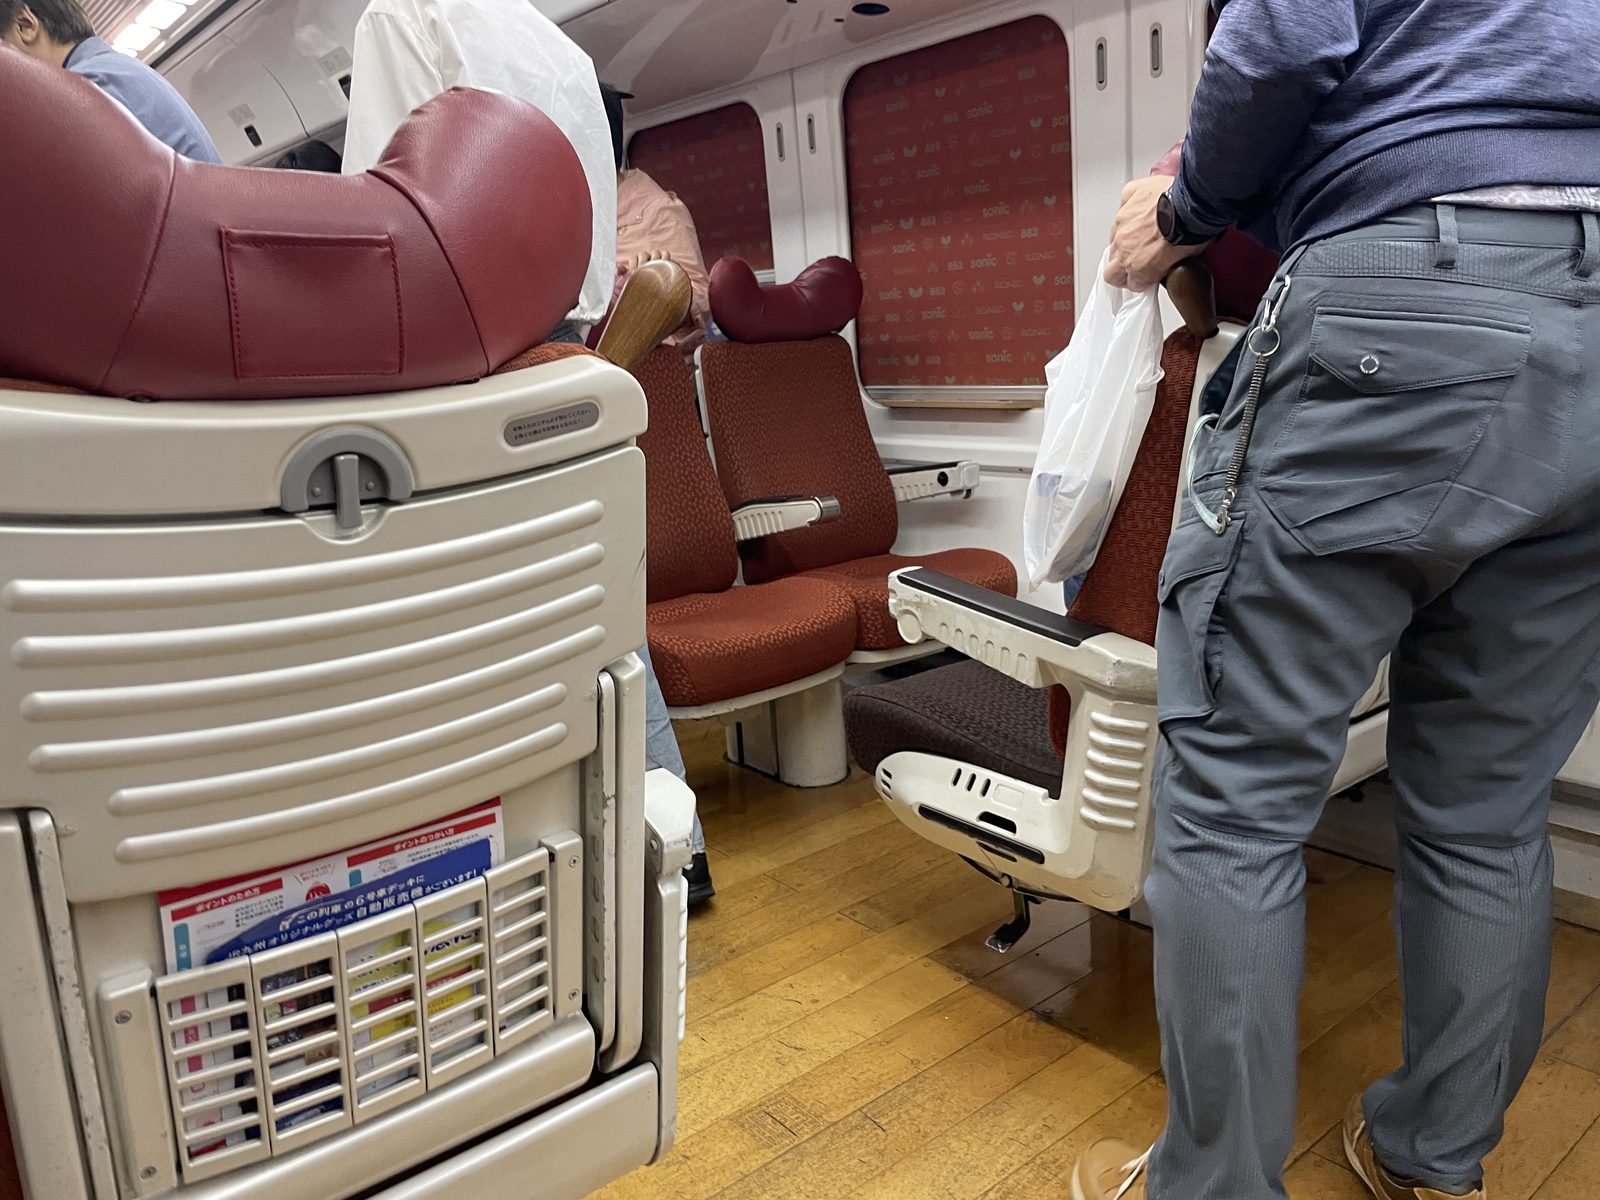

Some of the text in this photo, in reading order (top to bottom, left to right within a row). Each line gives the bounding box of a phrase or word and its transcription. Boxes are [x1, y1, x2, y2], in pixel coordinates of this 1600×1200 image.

[967, 101, 993, 120] sonic
[872, 148, 897, 167] sonic
[915, 164, 941, 180] sonic
[962, 179, 990, 195] sonic
[870, 219, 894, 235] sonic
[982, 202, 1010, 218] sonic
[891, 240, 917, 255] sonic
[1020, 226, 1039, 240] 883
[947, 260, 963, 272] 883
[969, 253, 997, 269] sonic
[879, 287, 902, 301] sonic
[929, 286, 945, 297] 883
[921, 306, 946, 321] sonic
[1052, 301, 1072, 312] 883
[968, 327, 994, 341] sonic
[985, 350, 1013, 364] sonic
